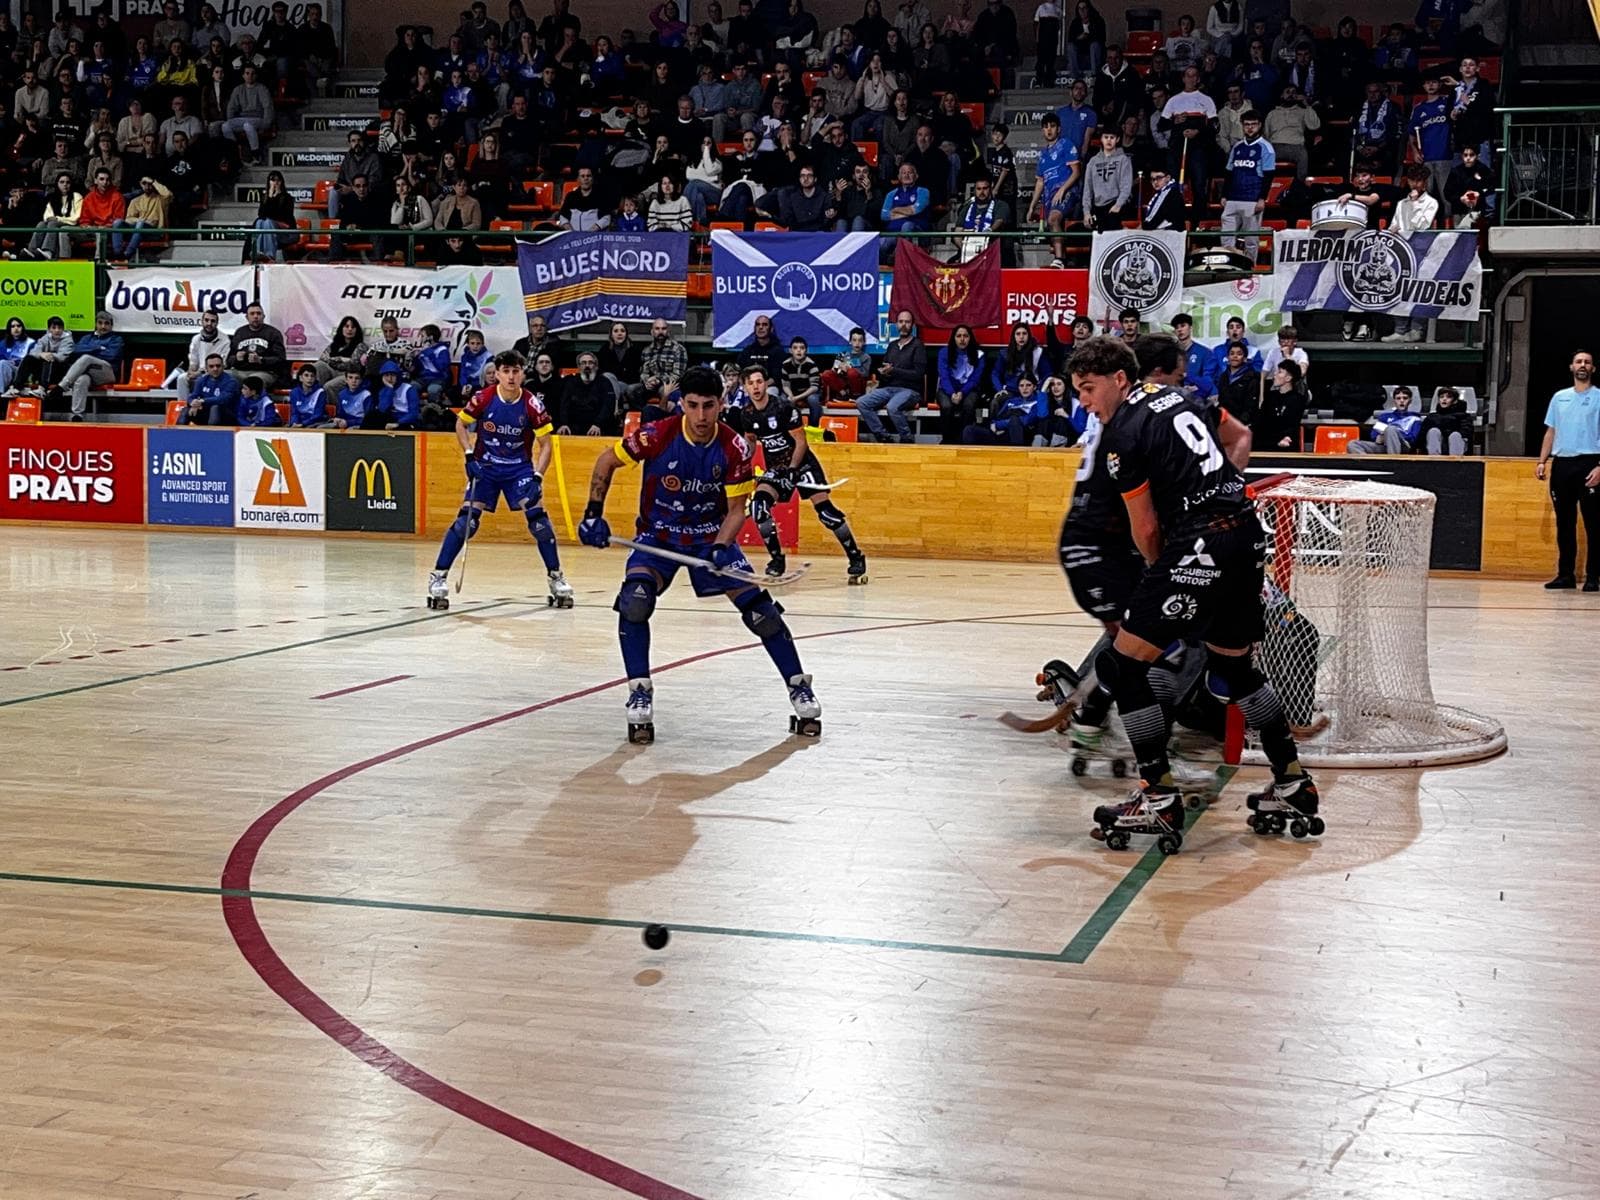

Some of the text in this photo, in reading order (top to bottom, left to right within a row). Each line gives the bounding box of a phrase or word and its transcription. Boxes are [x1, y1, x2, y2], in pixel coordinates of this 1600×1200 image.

[1279, 237, 1365, 264] ILERDAM
[536, 249, 671, 284] BLUES NORD
[1, 278, 68, 296] COVER
[716, 272, 875, 293] BLUES NORD
[340, 285, 459, 300] ACTIVA'T
[1007, 293, 1077, 308] FINQUES
[1401, 280, 1475, 306] VIDEAS
[373, 307, 412, 318] amb
[1006, 309, 1077, 325] PRATS
[153, 315, 203, 327] bonarea.c
[1173, 410, 1224, 476] 9
[8, 448, 114, 474] FINQUES
[161, 452, 206, 476] ASNL
[8, 474, 114, 502] PRATS
[161, 480, 227, 491] ADVANCED SPORT
[169, 493, 214, 503] NUTRITIONS
[215, 494, 229, 504] LAB
[367, 499, 397, 510] Lleida
[240, 508, 319, 524] bonarea.com
[1171, 574, 1212, 586] MOTORS
